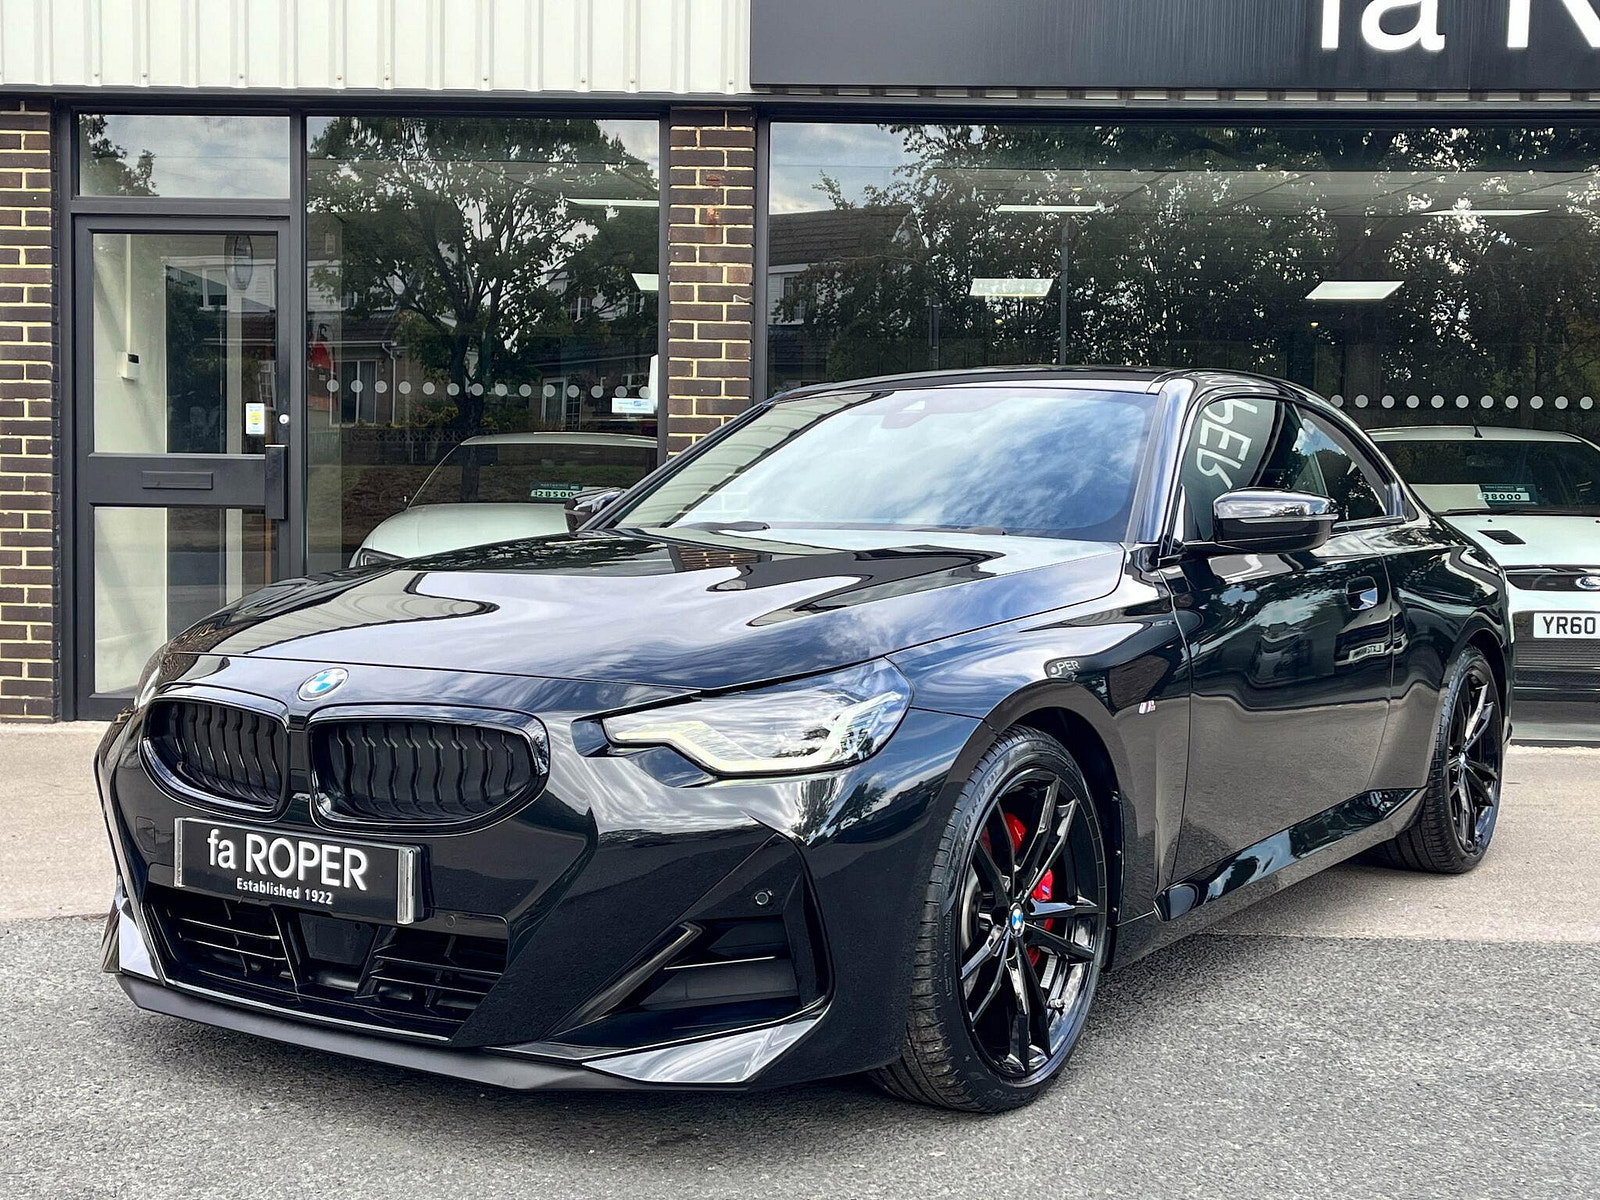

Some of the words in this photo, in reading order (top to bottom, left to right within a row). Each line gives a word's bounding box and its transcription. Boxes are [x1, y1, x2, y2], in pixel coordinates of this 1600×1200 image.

[1542, 616, 1596, 635] YR60
[207, 828, 236, 870] fa
[245, 833, 368, 891] ROPER
[236, 877, 299, 900] Established
[304, 888, 333, 905] 1922
